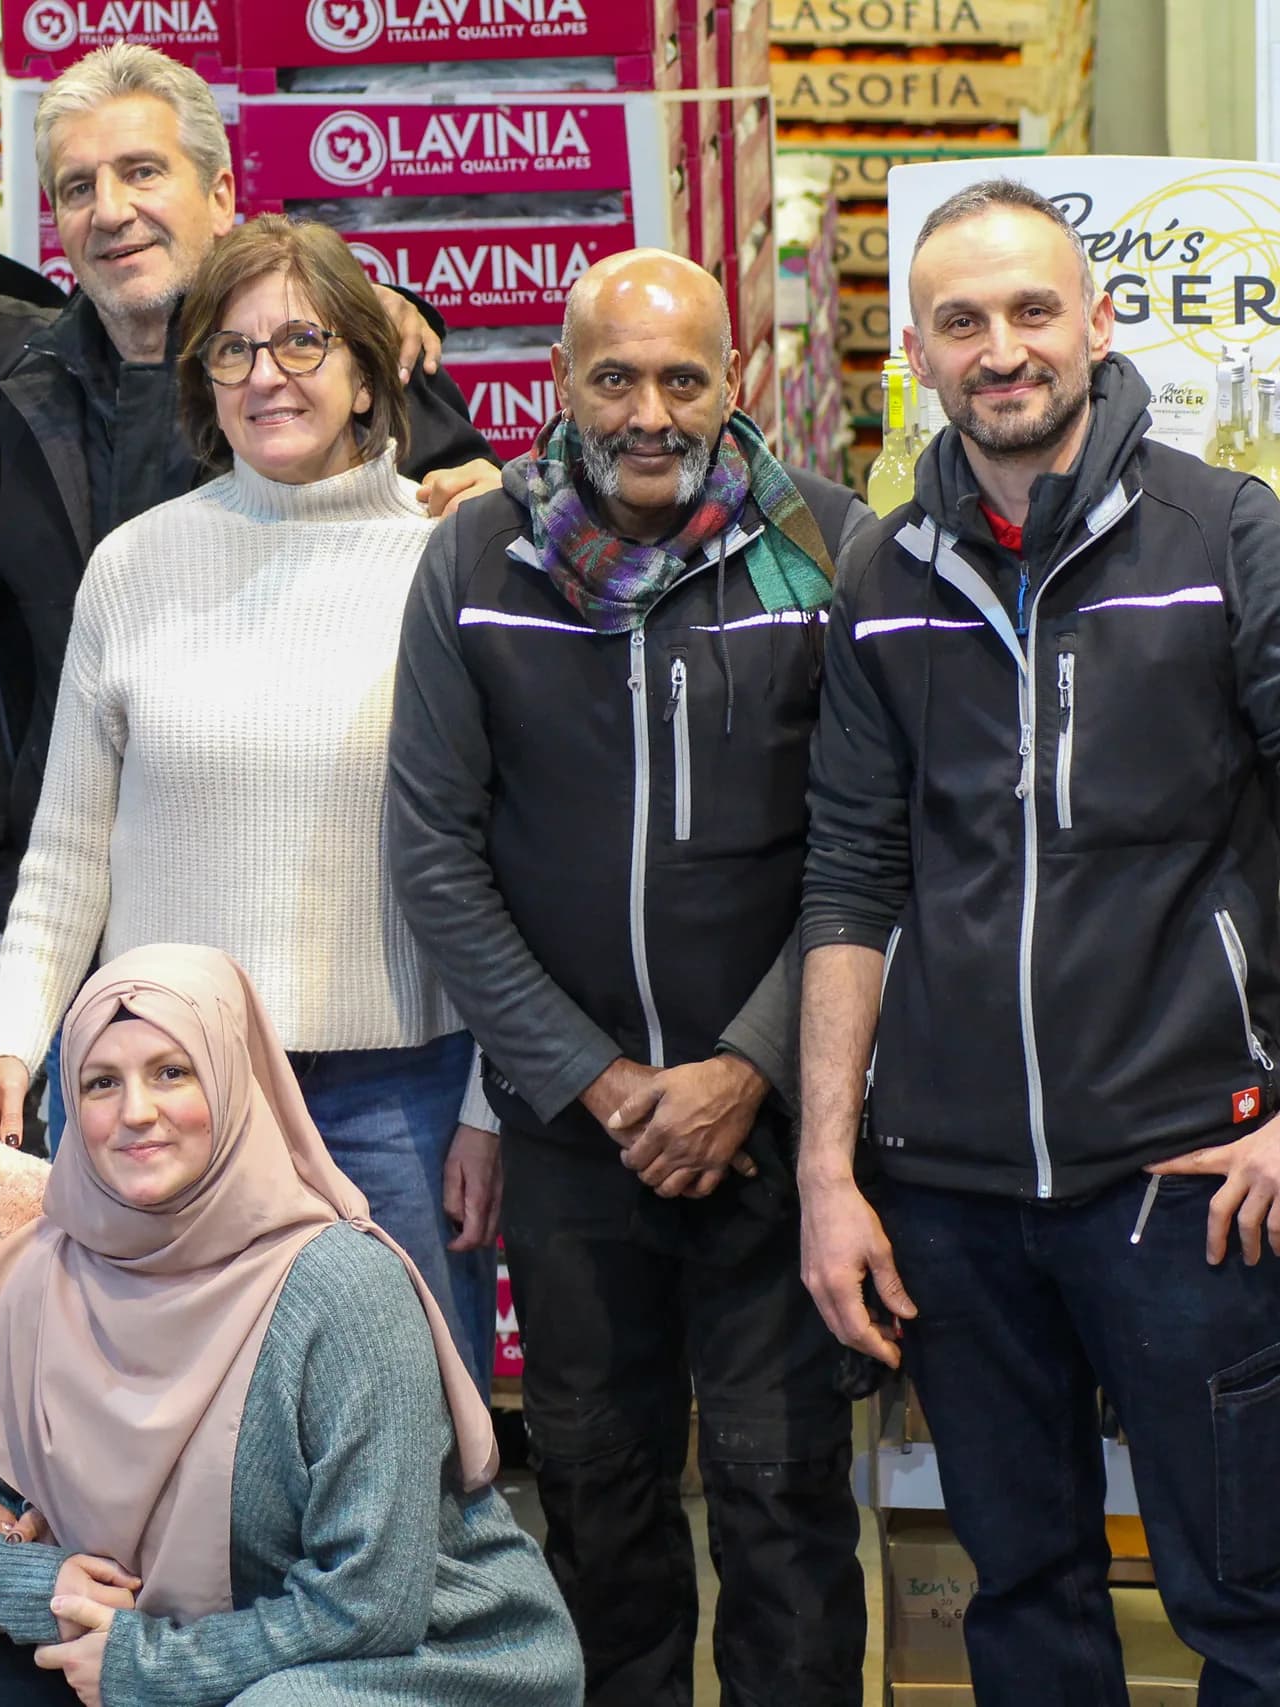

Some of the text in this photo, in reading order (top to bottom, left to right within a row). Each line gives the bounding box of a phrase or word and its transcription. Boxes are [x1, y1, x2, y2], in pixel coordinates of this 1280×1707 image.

[76, 0, 218, 33] LAVINIA
[126, 33, 175, 44] QUALITY
[177, 32, 219, 43] GRAPES
[387, 21, 588, 42] ITALIAN QUALITY GRAPES
[387, 109, 590, 161] LAVINIA
[390, 155, 591, 177] ITALIAN QUALITY GRAPES
[396, 241, 592, 292] LAVINIA
[469, 289, 538, 306] QUALITY
[1104, 273, 1280, 325] GER
[468, 379, 558, 427] VINI
[1150, 394, 1205, 406] GINGER
[480, 426, 537, 441] UALITY
